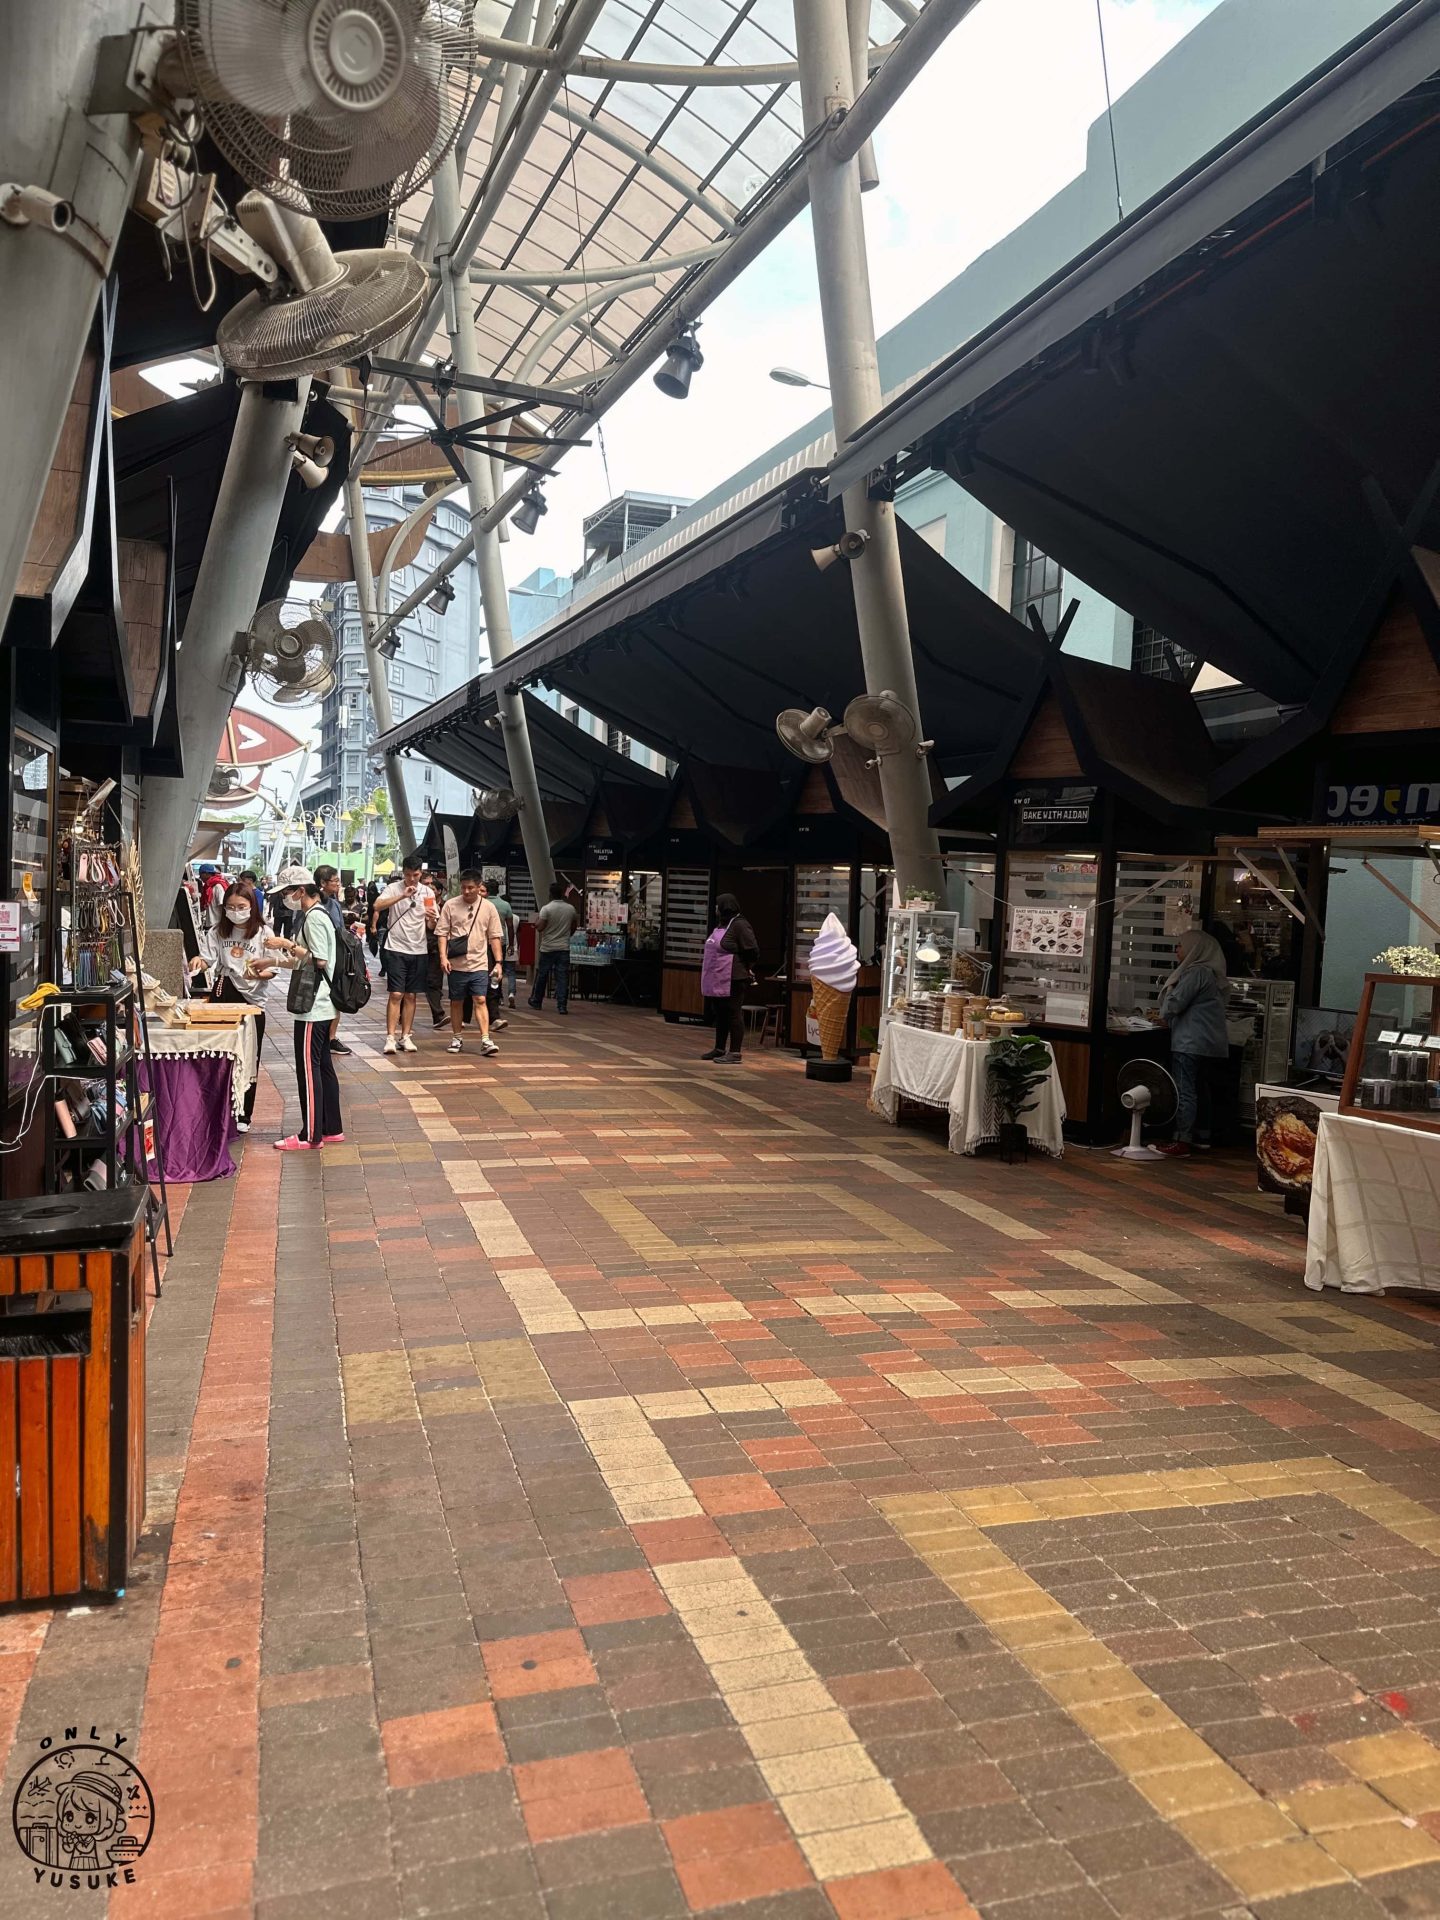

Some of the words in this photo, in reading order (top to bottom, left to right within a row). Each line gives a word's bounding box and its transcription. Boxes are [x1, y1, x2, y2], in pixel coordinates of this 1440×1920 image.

[1023, 810, 1042, 820] BAKE
[1043, 810, 1063, 820] WITH
[1063, 810, 1088, 820] AIDAN
